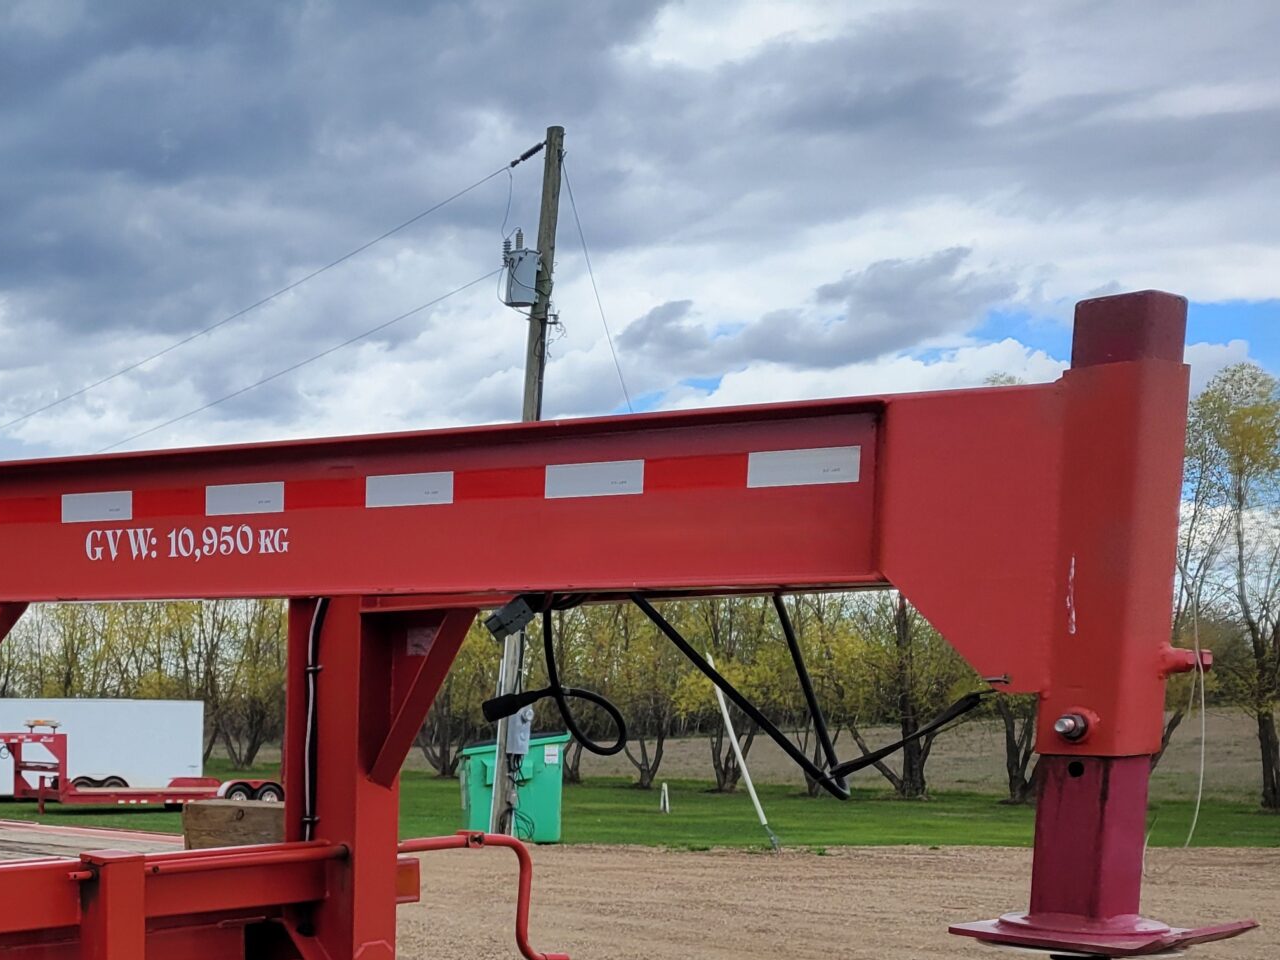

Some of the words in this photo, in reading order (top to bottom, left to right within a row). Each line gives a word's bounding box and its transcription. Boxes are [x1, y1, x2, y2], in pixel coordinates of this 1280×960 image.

[85, 527, 157, 561] GVW:
[167, 523, 253, 562] 10,950
[257, 527, 290, 554] KG
